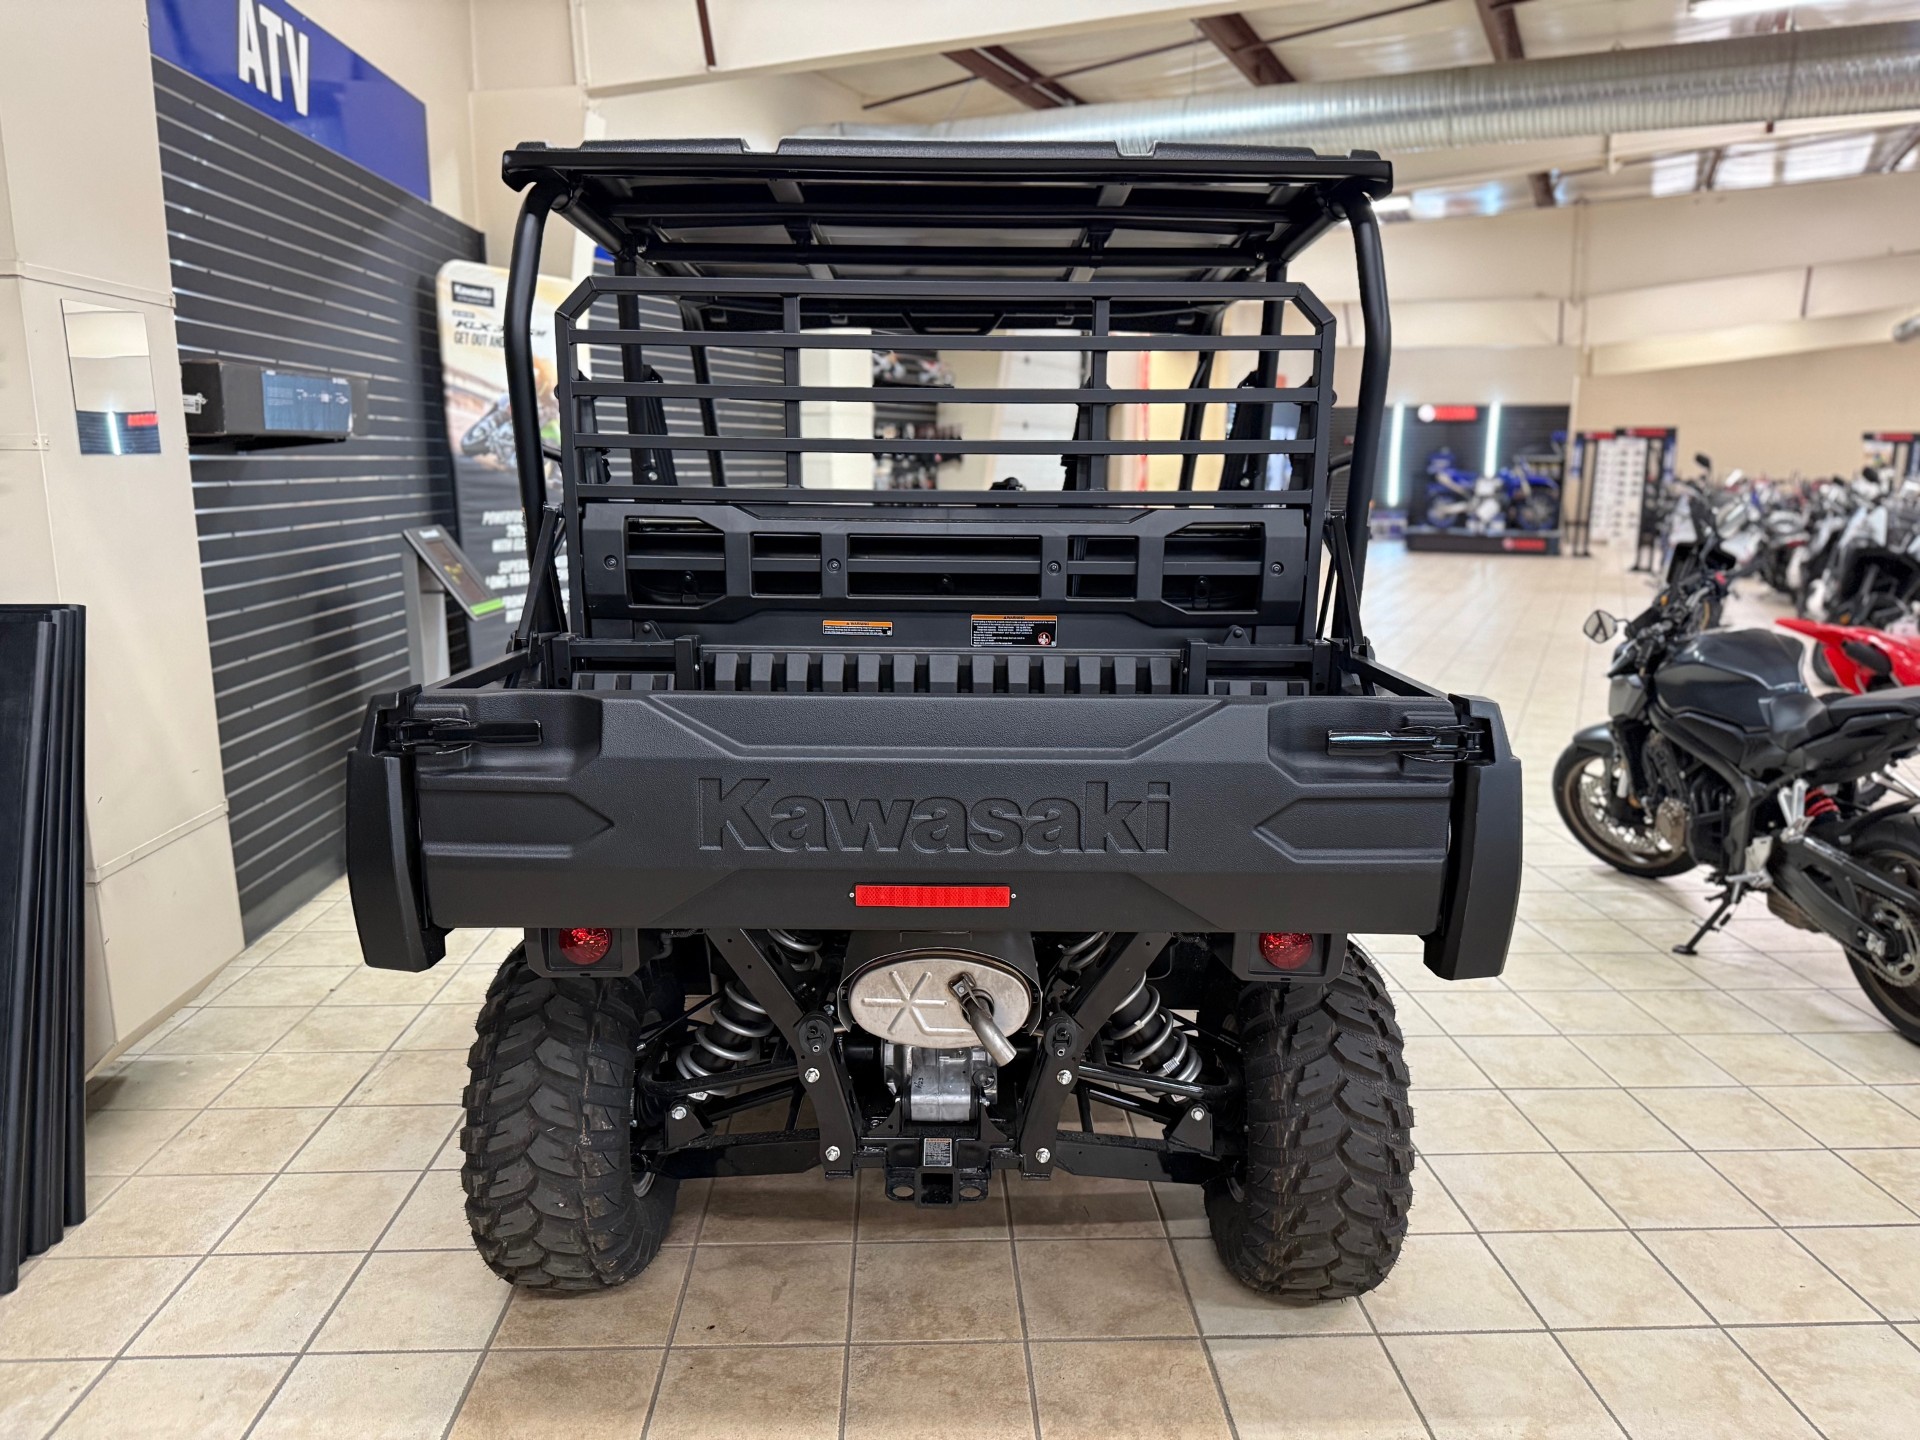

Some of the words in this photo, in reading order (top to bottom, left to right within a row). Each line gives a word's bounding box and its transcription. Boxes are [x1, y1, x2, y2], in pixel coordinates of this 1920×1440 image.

[239, 0, 308, 116] ATV
[454, 331, 469, 344] GET
[471, 333, 488, 346] OUT
[456, 321, 491, 332] KLX
[699, 778, 1170, 855] Kawasaki
